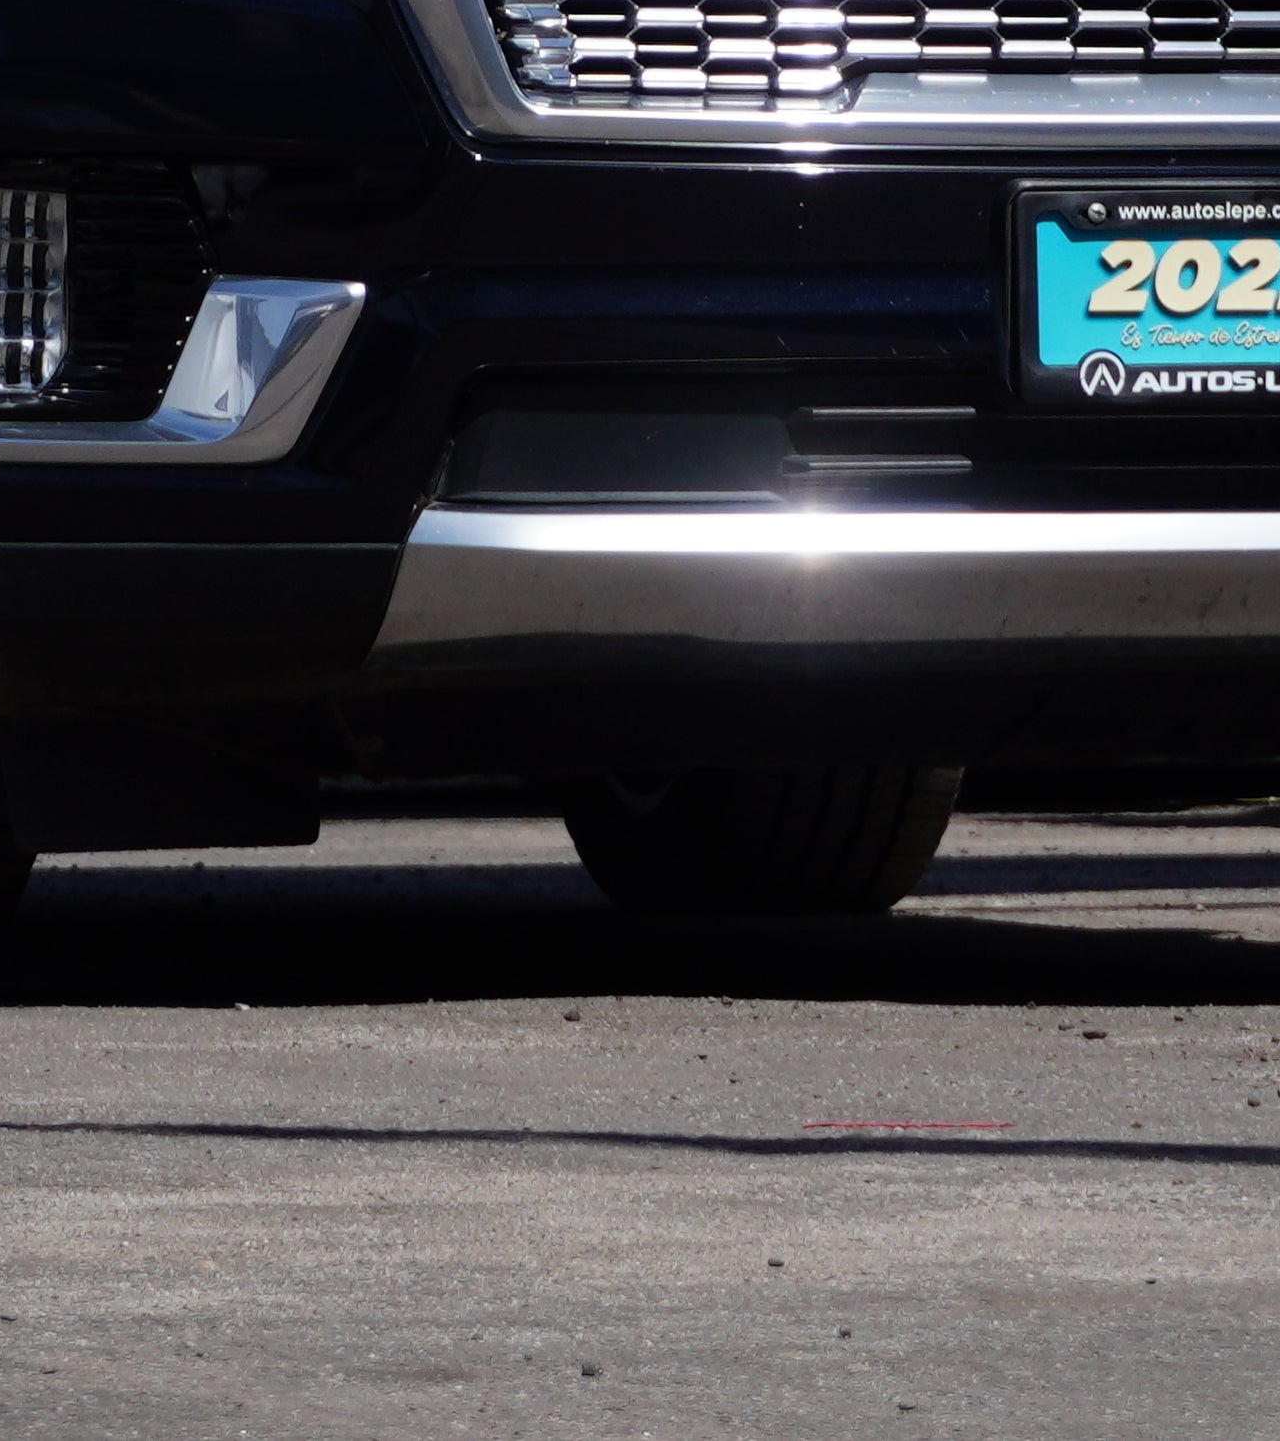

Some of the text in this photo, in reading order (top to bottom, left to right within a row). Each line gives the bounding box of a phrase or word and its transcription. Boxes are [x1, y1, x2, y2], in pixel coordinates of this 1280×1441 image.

[1120, 321, 1143, 349] Es
[1149, 324, 1205, 348] Tiempo
[1209, 329, 1231, 346] de
